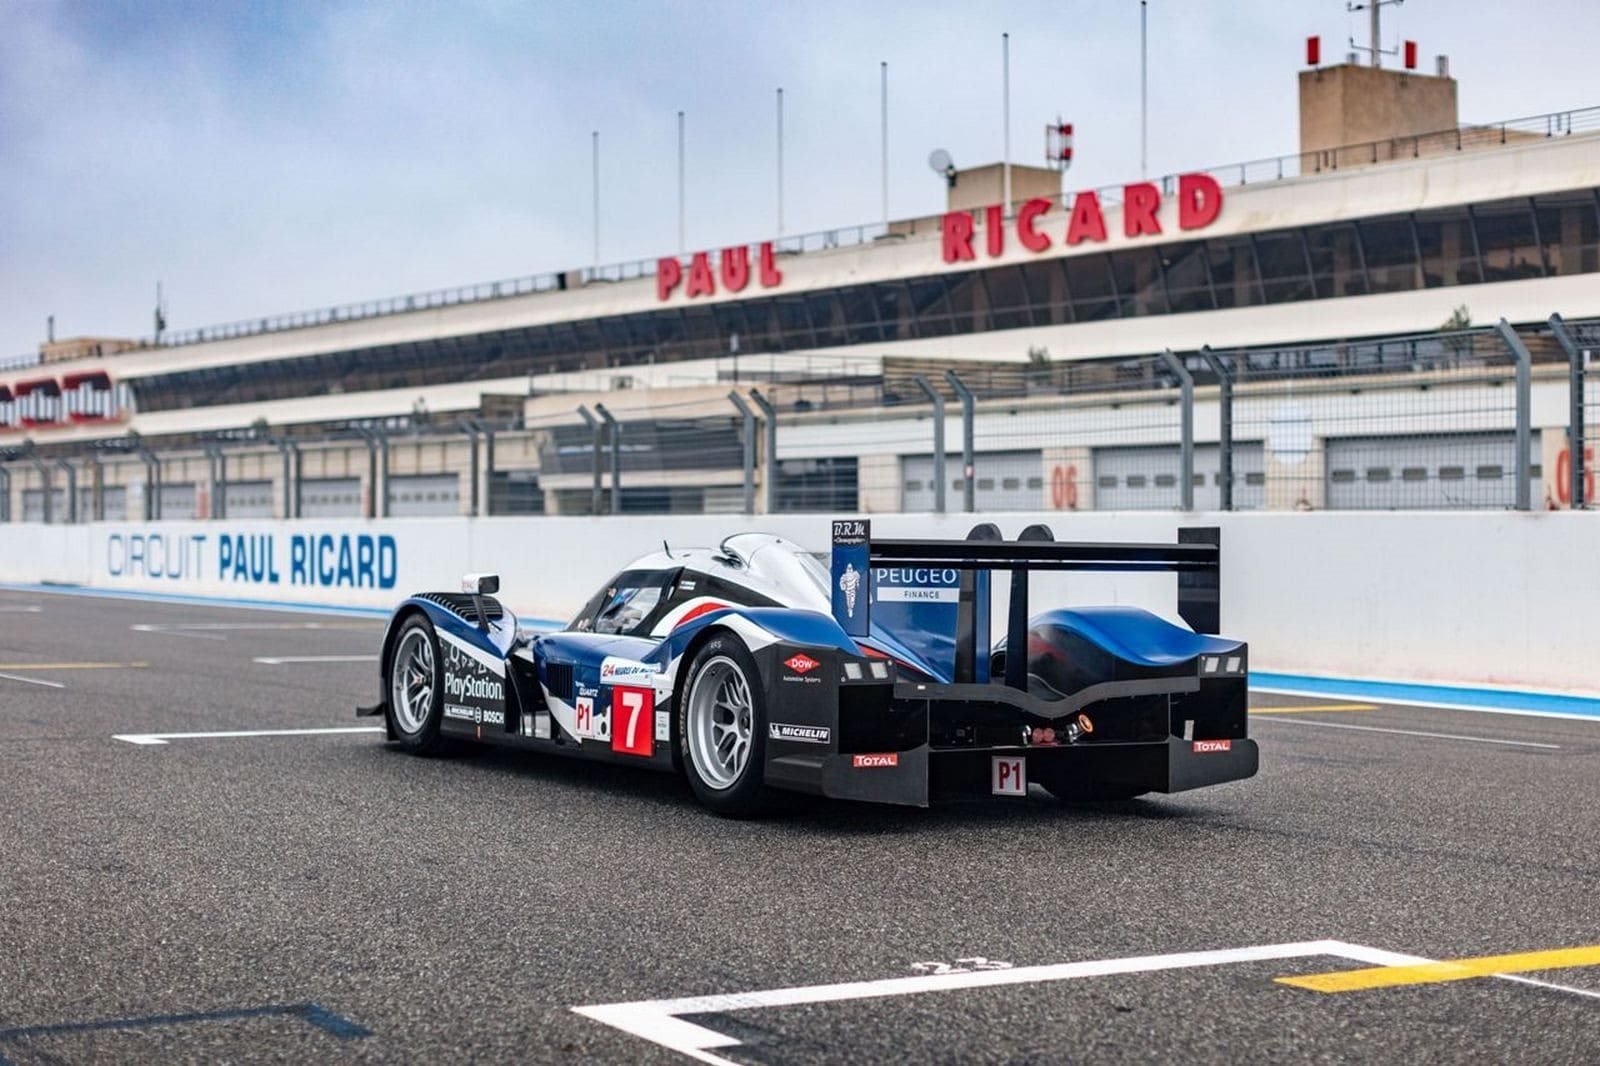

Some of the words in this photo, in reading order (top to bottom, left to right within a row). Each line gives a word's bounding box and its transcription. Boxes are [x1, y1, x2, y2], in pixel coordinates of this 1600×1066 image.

[657, 242, 781, 300] PAUL
[943, 173, 1222, 263] RICARD
[108, 535, 206, 578] CIRCUIT
[219, 535, 279, 584] PAUL
[291, 535, 397, 590] RICARD
[876, 568, 960, 584] PEUGEO
[904, 591, 939, 600] FINANCE
[602, 664, 615, 677] 24
[444, 672, 504, 703] PlayStation
[483, 709, 504, 724] BOSCH
[577, 703, 590, 730] P1
[622, 691, 643, 748] 7
[782, 727, 828, 739] MICHELIN
[1197, 741, 1230, 752] TOTAL
[859, 755, 894, 766] TOTAL
[999, 761, 1020, 790] P1
